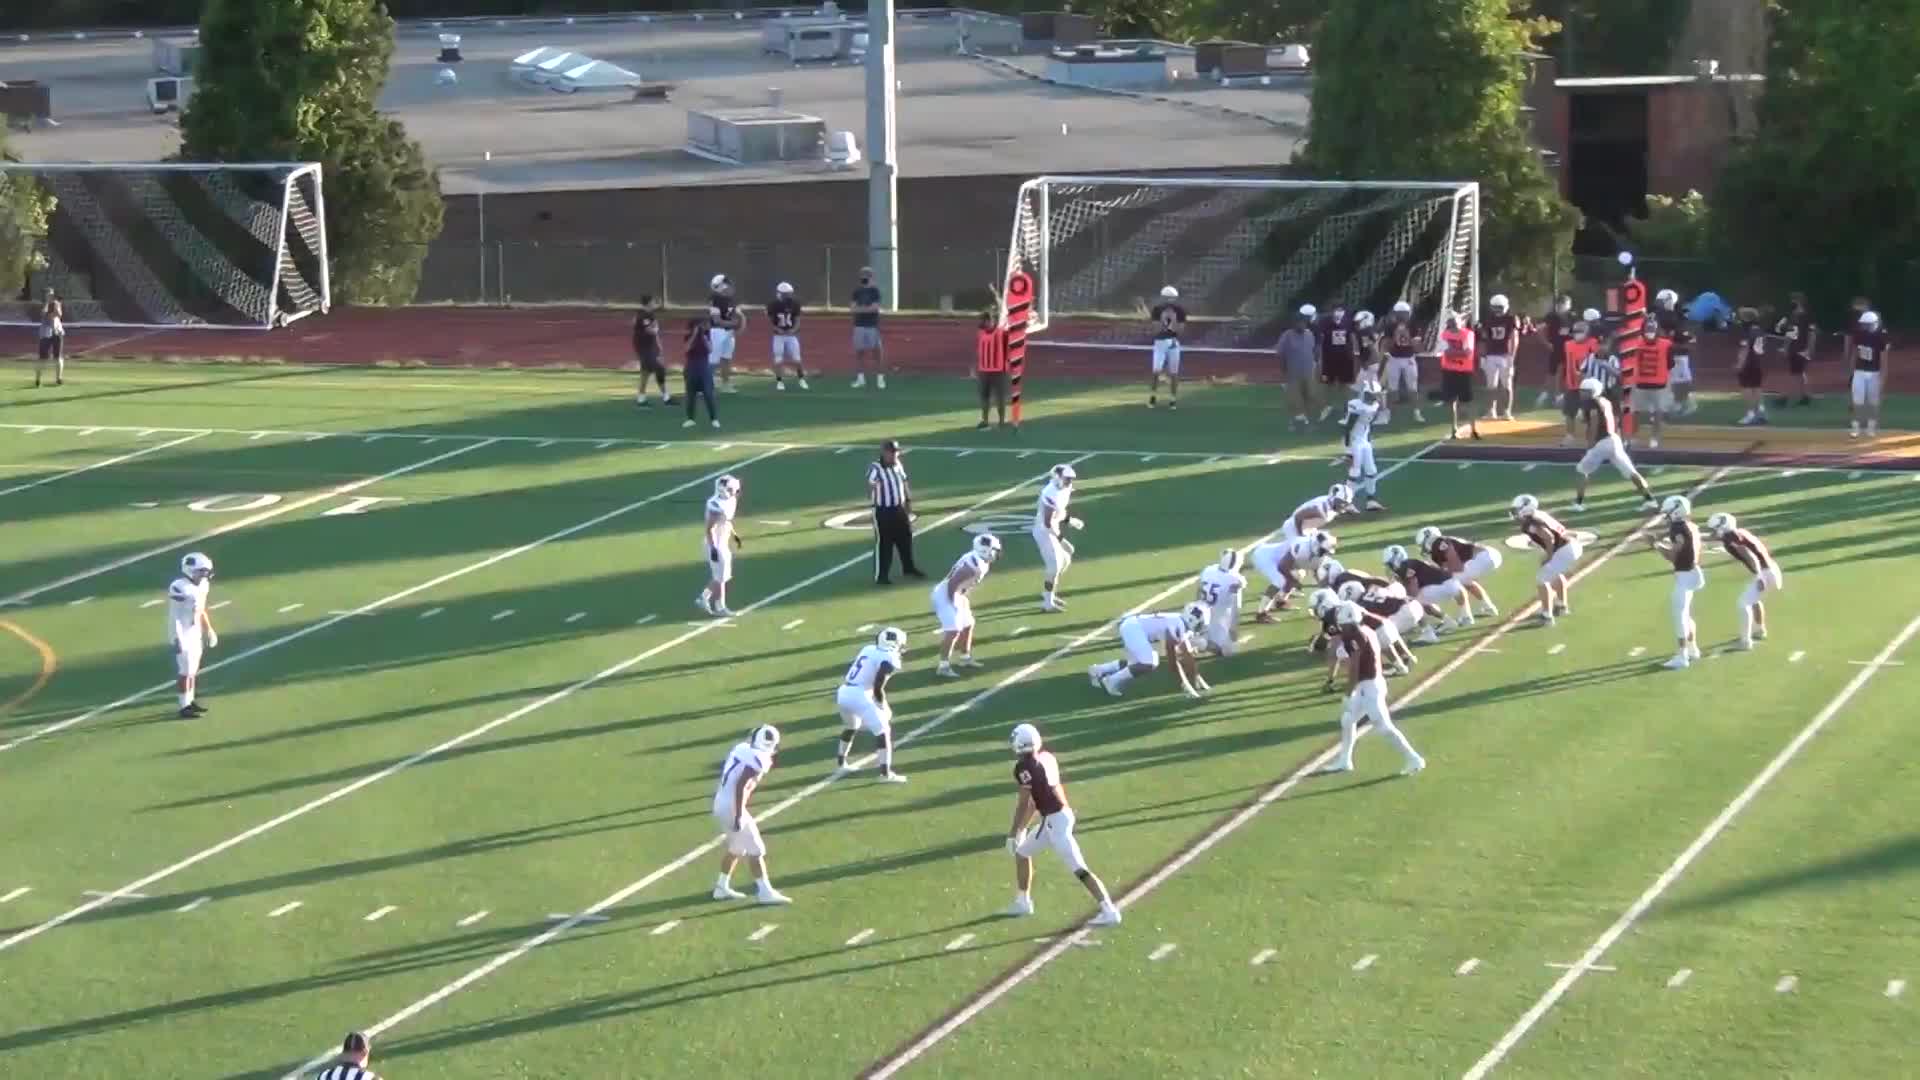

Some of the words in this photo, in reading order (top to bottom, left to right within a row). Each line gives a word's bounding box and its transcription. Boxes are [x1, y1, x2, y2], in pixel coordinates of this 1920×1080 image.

[1200, 581, 1220, 605] 55
[849, 655, 868, 681] 5
[721, 755, 741, 787] 7
